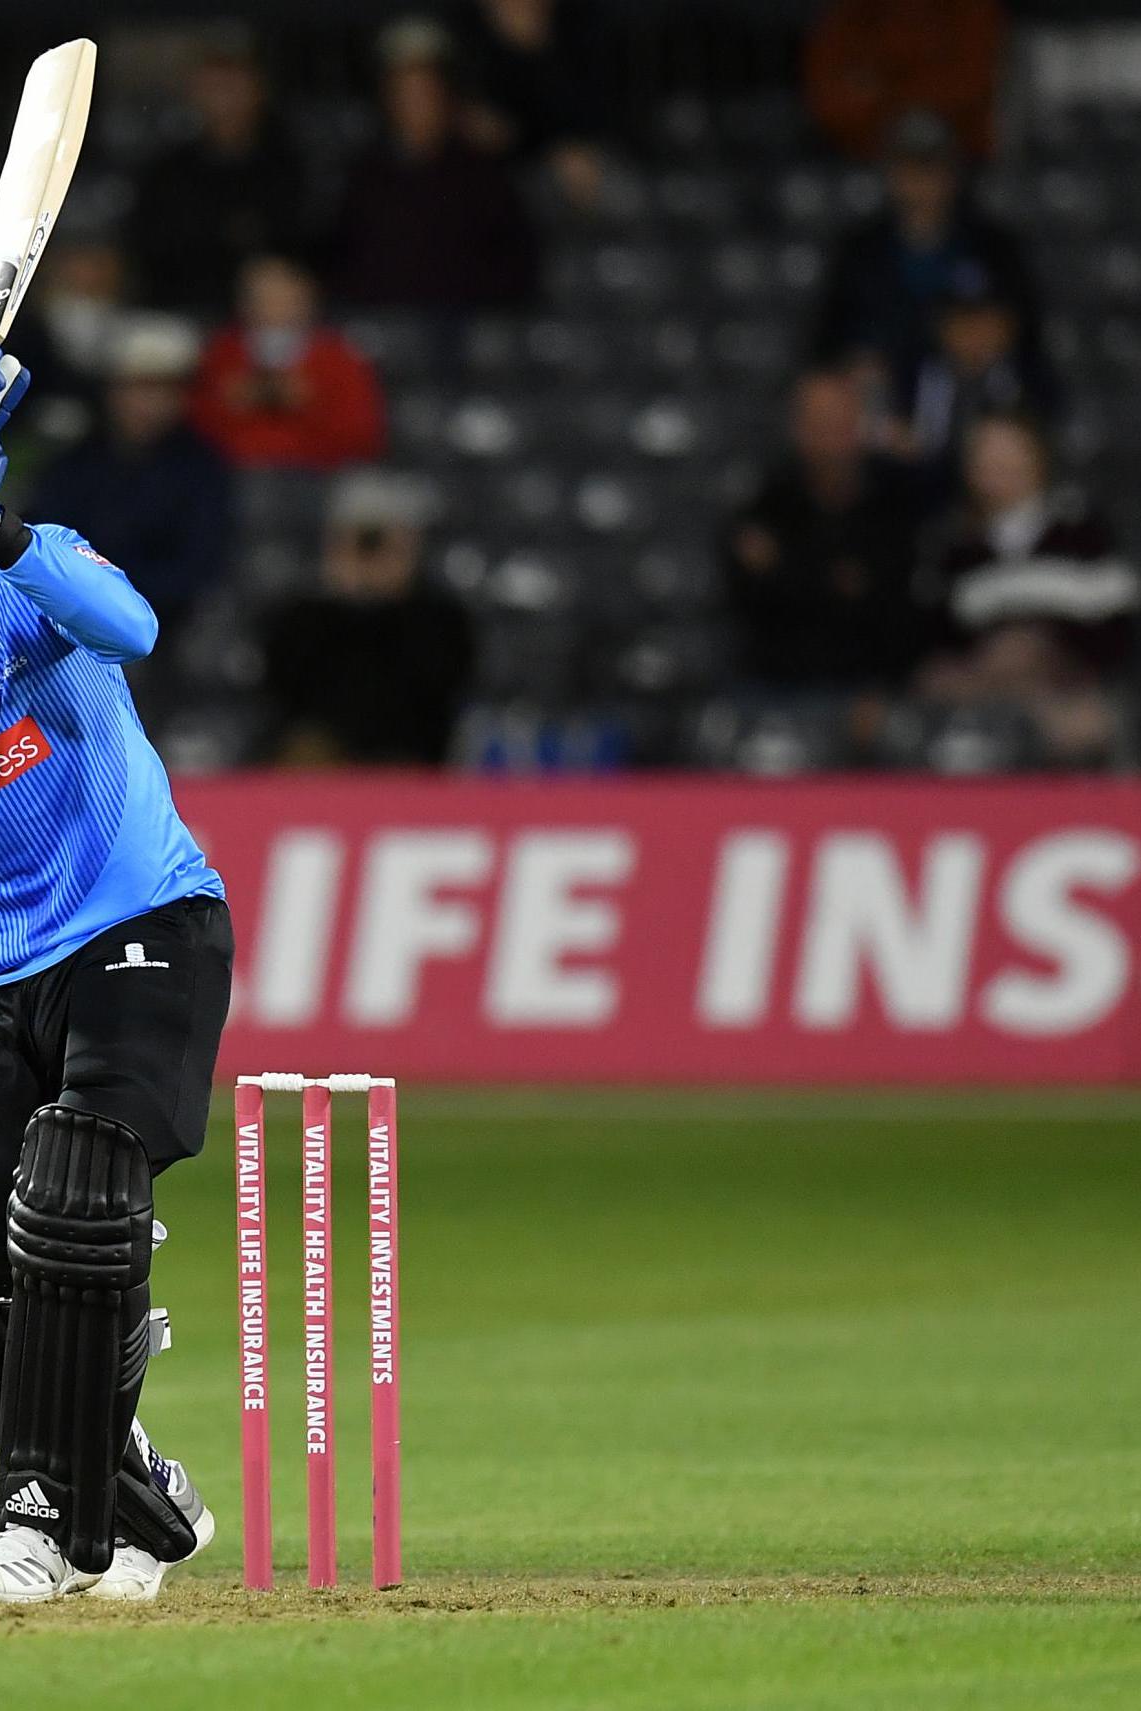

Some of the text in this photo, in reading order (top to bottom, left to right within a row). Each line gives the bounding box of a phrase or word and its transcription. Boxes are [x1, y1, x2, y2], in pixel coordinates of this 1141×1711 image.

[232, 827, 1141, 1037] IFE INS
[238, 1123, 265, 1411] VITALITY LIFE INSURANCE
[305, 1124, 326, 1455] VITALITY HEALTH INSURANCE
[369, 1124, 393, 1385] VITALITY INVESTMENTS
[5, 1499, 60, 1520] adidas
